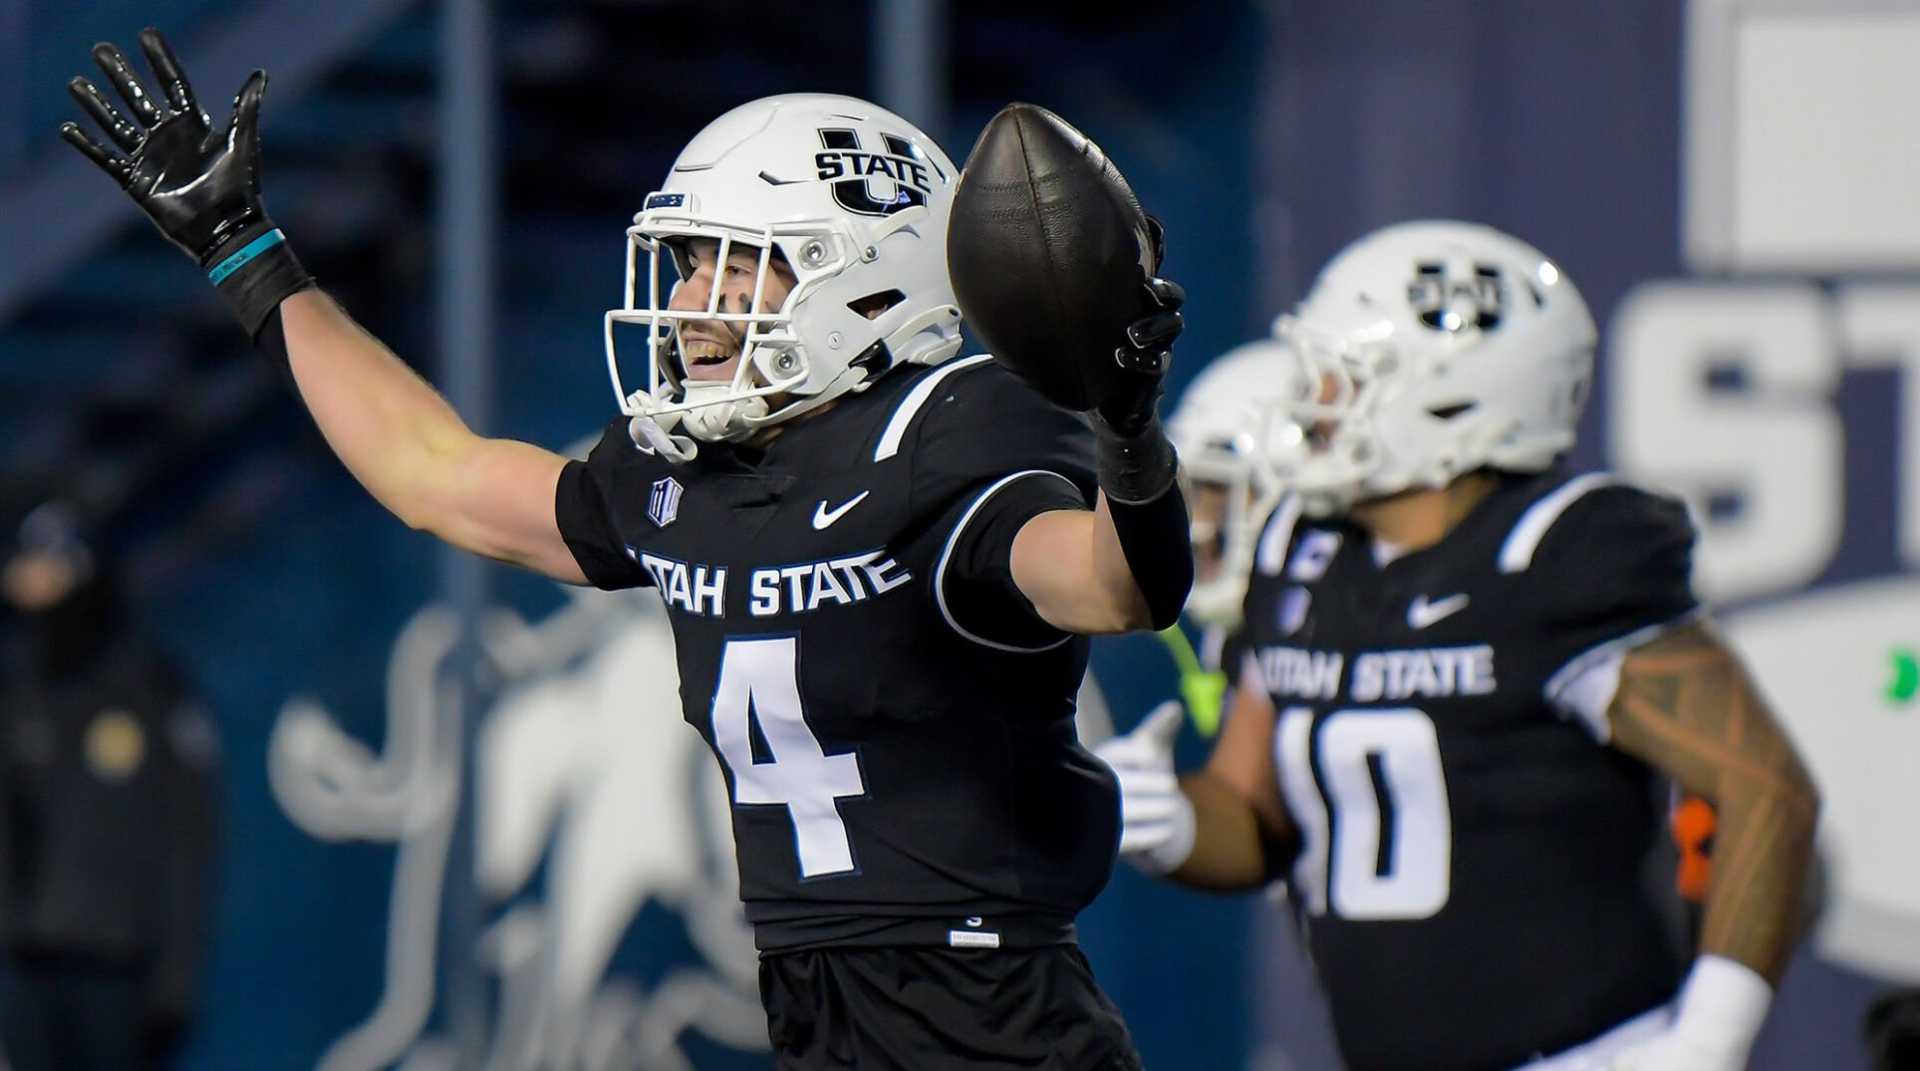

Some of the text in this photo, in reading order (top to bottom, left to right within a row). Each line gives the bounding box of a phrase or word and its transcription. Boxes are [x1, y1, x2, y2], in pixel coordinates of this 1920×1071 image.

[815, 152, 932, 194] STATE
[625, 545, 912, 617] TAH STATE
[1351, 643, 1497, 703] STATE
[712, 632, 871, 882] 4
[1274, 706, 1452, 921] 10
